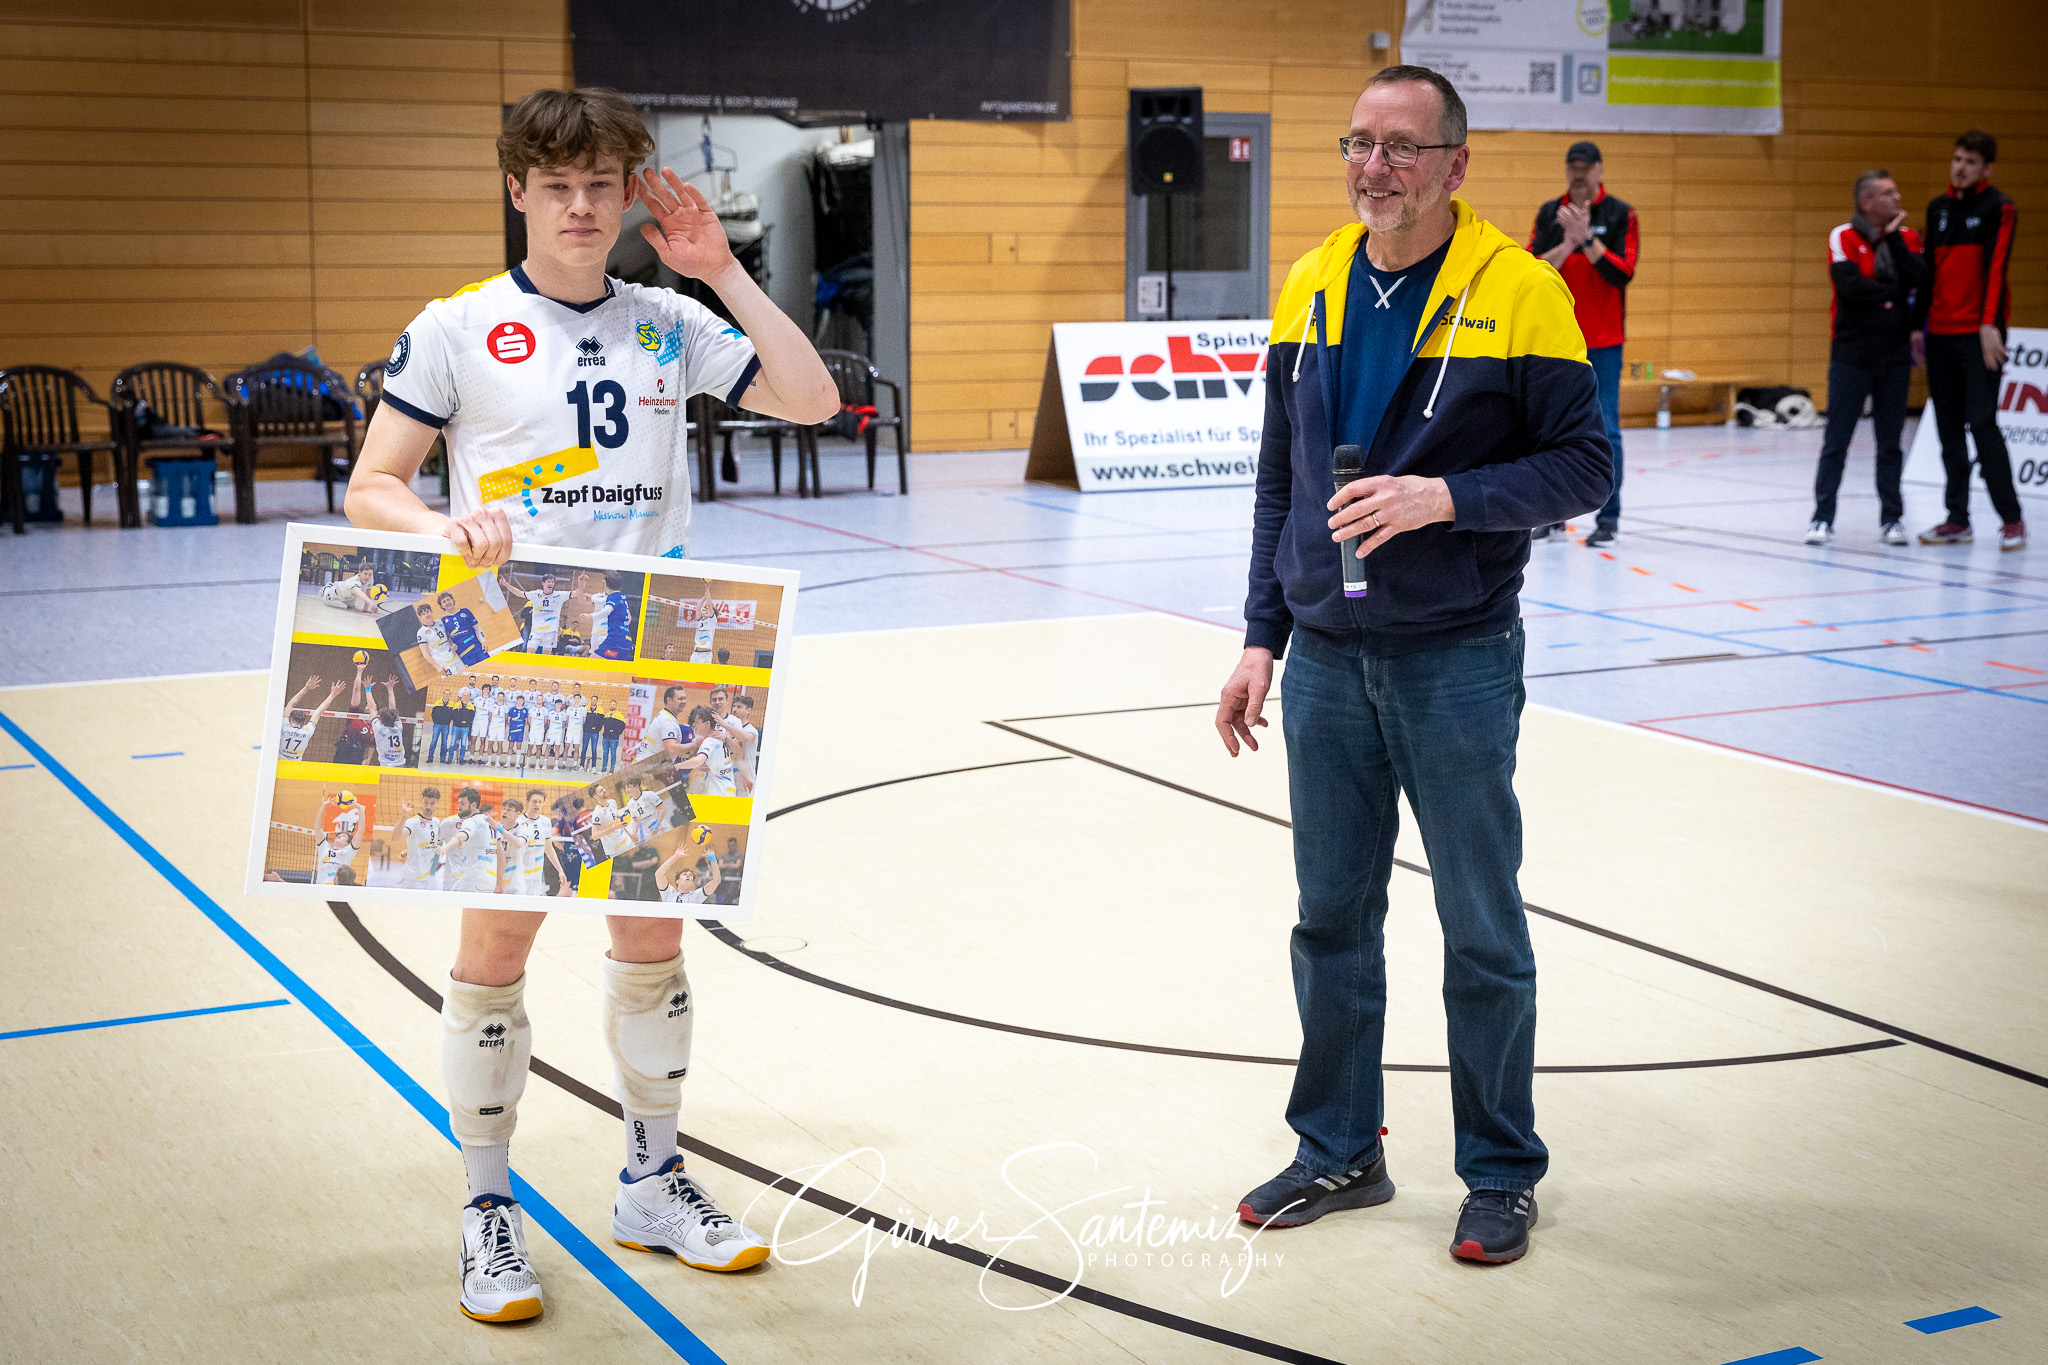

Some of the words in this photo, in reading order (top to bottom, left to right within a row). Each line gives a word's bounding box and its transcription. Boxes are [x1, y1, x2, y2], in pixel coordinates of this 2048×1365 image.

[566, 379, 630, 449] 13
[1084, 432, 1108, 446] Ihr
[1114, 430, 1203, 448] Spezialist
[1208, 426, 1231, 442] für
[1091, 456, 1255, 480] www.schwei
[541, 485, 589, 507] Zapf
[592, 483, 663, 506] Daigfuss
[284, 737, 302, 752] 17
[387, 735, 401, 748] 13
[533, 829, 540, 840] 2
[633, 1119, 648, 1152] CRAFT
